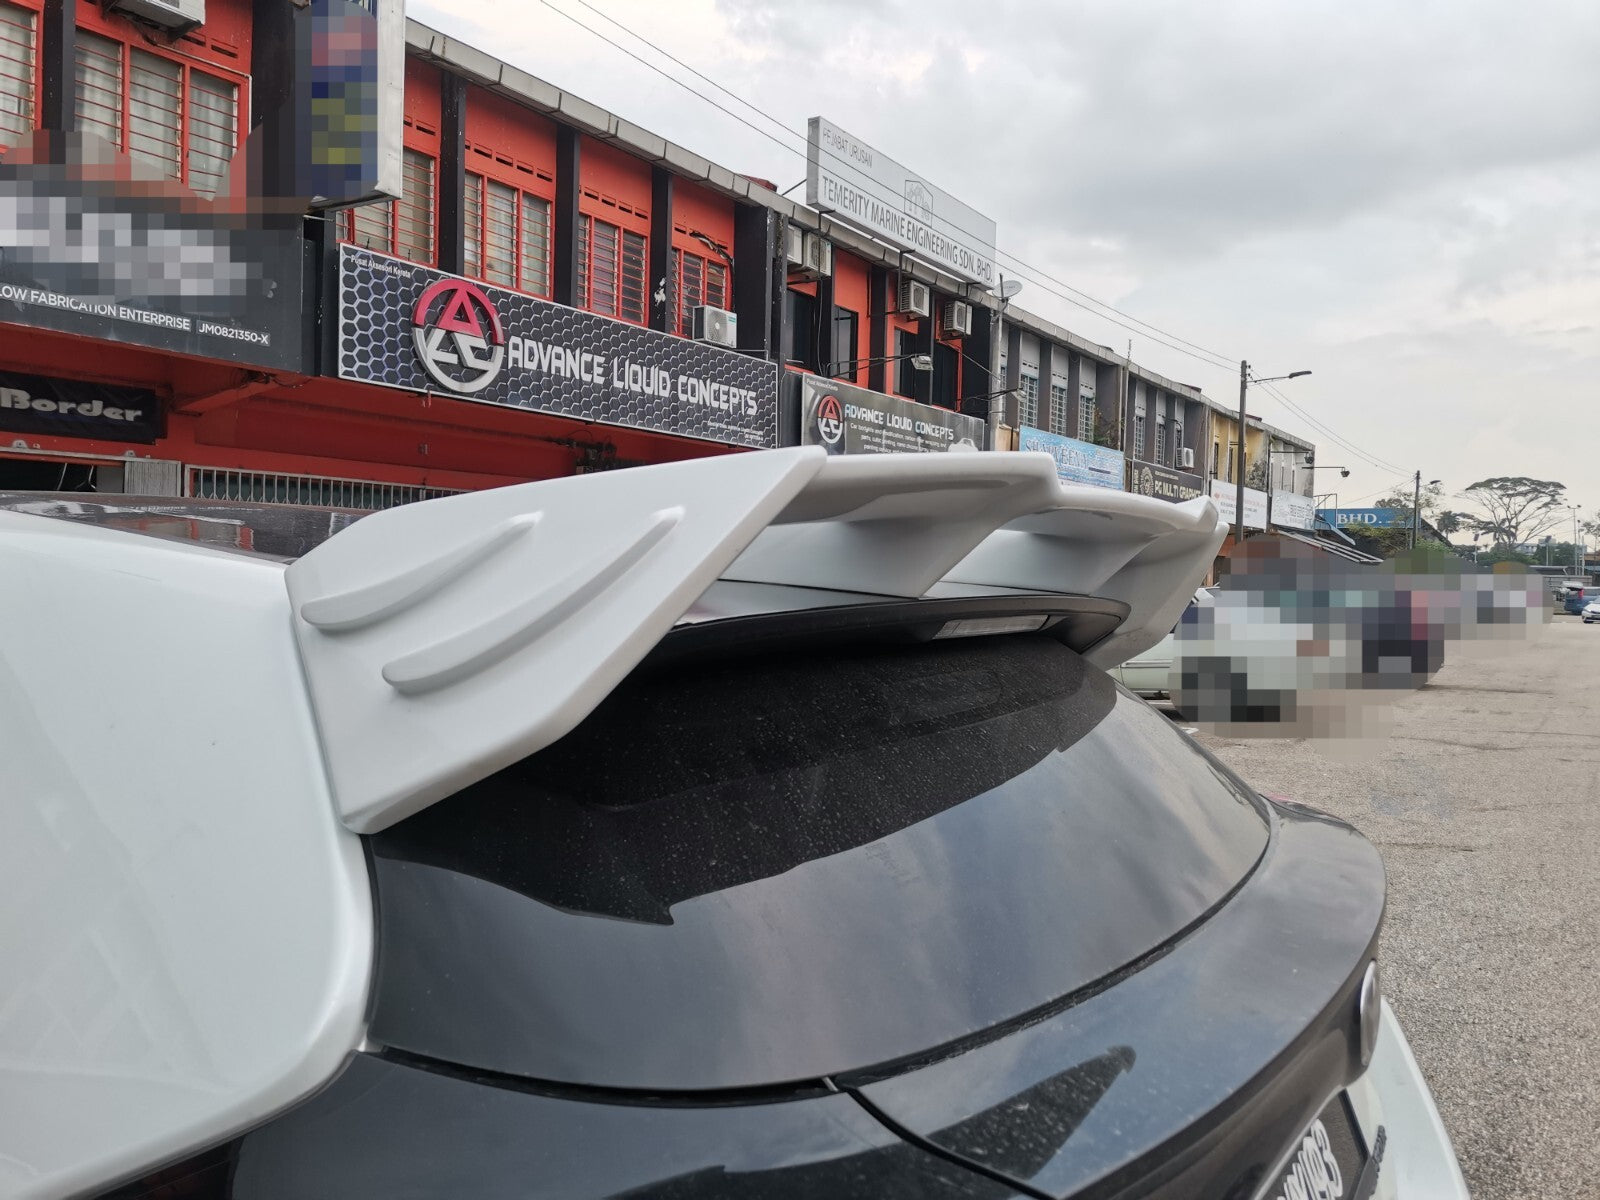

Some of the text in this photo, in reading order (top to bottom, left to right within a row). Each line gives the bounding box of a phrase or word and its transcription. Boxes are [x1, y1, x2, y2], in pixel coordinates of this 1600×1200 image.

[849, 141, 873, 169] URUSAN
[822, 175, 993, 283] TEMERITY MARINE ENGINEERING SDN. BHD.
[119, 307, 191, 331] ENTERPRISE
[199, 322, 270, 345] JM0821350-X
[507, 335, 758, 416] ADVANCE LIQUID CONCEPTS
[0, 386, 143, 422] Border
[844, 403, 954, 441] ADVANCE LIQUID CONCEPTS
[1154, 479, 1163, 495] PG
[1336, 512, 1383, 525] BHD.
